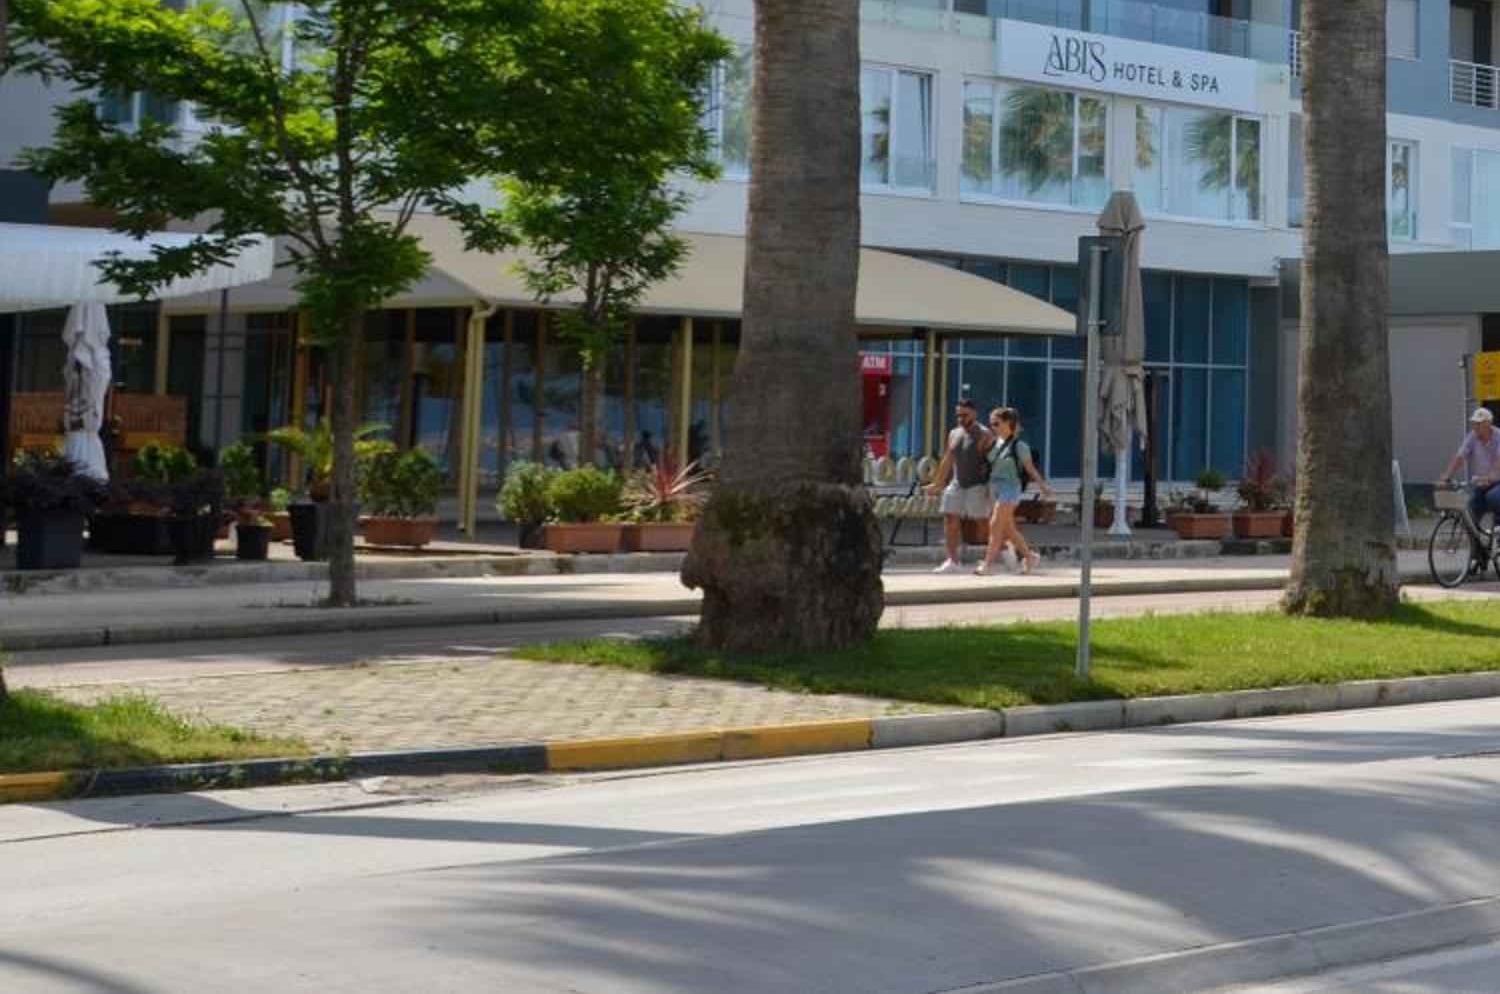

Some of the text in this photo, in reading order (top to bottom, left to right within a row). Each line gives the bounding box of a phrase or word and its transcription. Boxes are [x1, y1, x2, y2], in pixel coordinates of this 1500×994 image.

[1043, 35, 1219, 94] ABIS HOTEL & SPA
